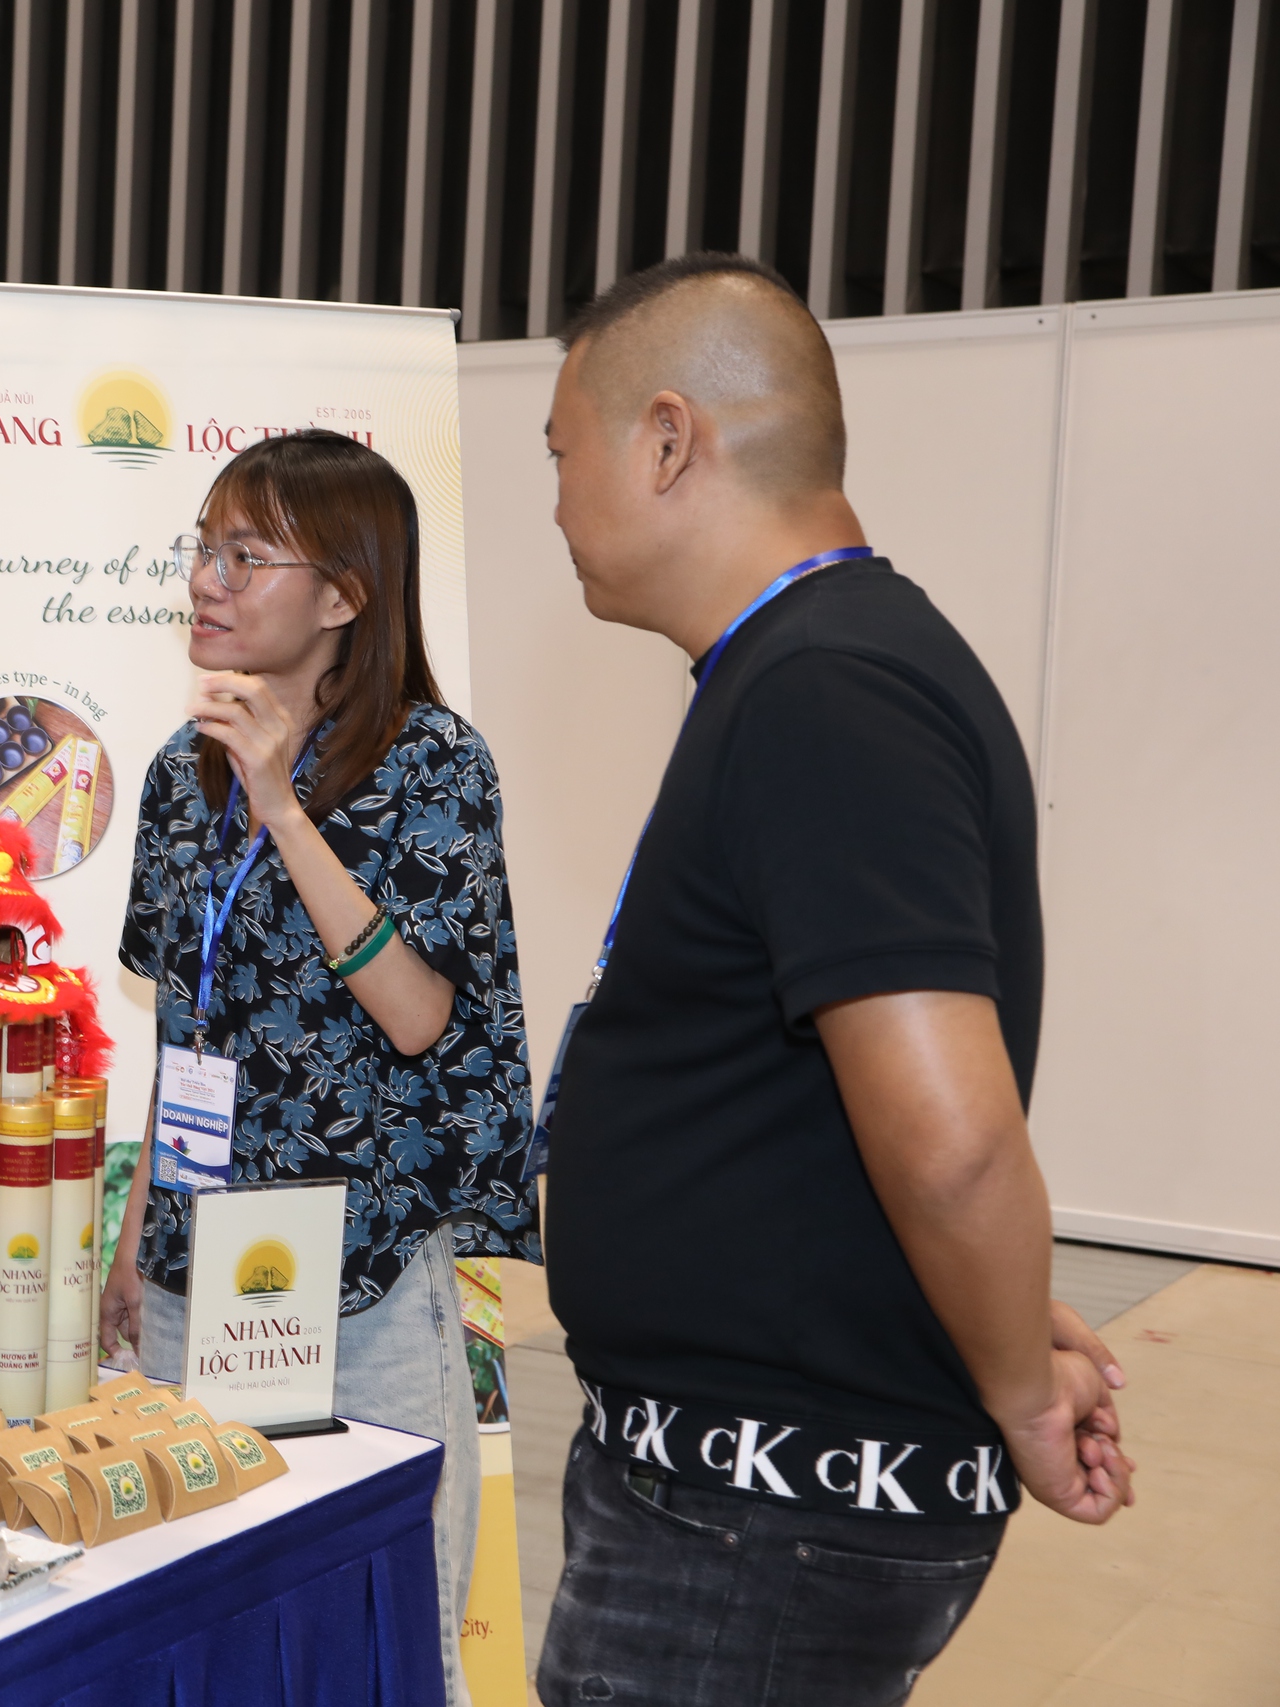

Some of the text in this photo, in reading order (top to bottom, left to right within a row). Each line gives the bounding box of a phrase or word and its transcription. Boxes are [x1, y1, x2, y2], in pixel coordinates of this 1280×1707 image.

[14, 392, 34, 405] NÚI
[316, 406, 372, 420] EST. 2005
[186, 417, 247, 461] LỘC
[103, 545, 140, 585] of
[42, 592, 195, 625] the essen
[13, 671, 48, 688] type
[64, 681, 80, 699] in
[80, 692, 109, 722] bag
[163, 1108, 229, 1134] DOANH NGHIỆP
[2, 1268, 42, 1280] NHANG
[201, 1316, 322, 1346] EST. NHANG 2005
[199, 1342, 321, 1380] LỘC THÀNH
